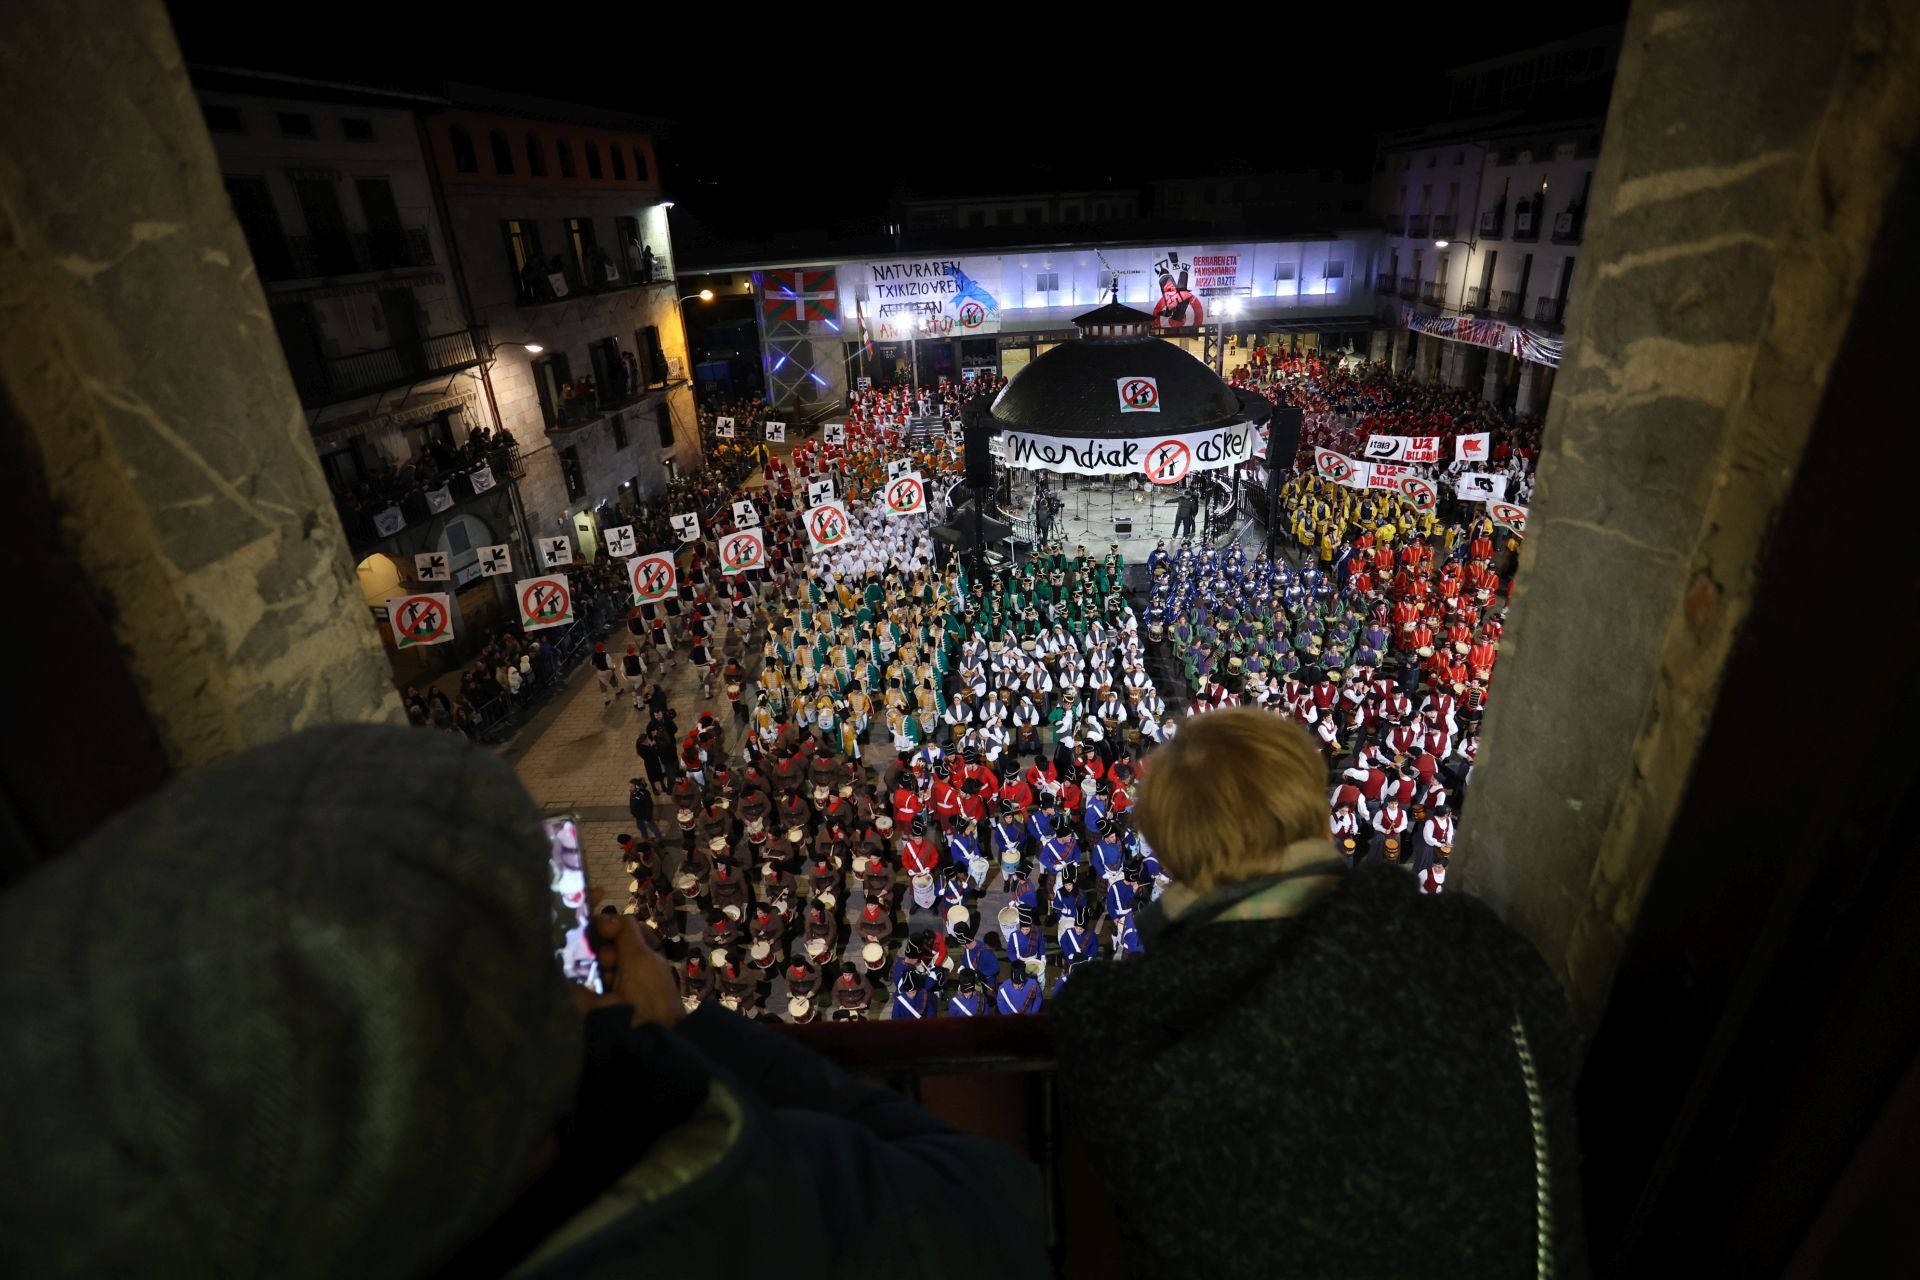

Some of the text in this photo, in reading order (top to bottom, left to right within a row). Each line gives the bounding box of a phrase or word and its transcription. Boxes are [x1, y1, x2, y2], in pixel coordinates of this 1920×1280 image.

[1226, 256, 1237, 265] ETA
[873, 261, 961, 281] NATURAREN
[1007, 431, 1248, 470] Mendiak aske!
